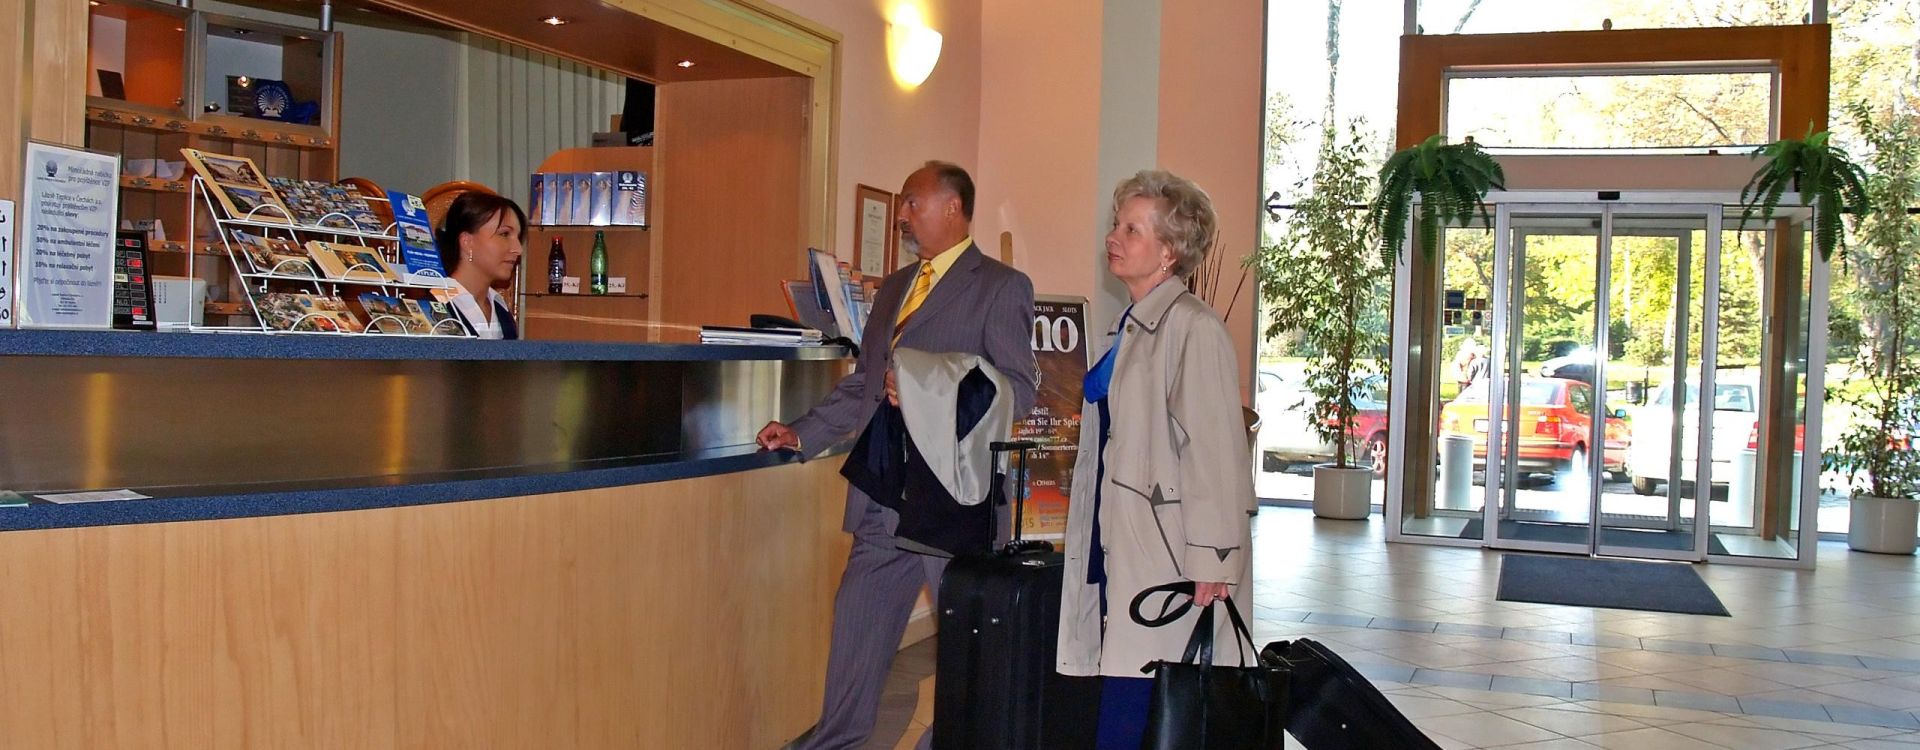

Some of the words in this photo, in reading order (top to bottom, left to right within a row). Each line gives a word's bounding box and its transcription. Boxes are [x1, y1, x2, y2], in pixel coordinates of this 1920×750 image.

[36, 248, 48, 256] 20%
[1037, 417, 1048, 426] Sie
[1050, 417, 1062, 426] Ihr
[1063, 417, 1081, 428] Spie
